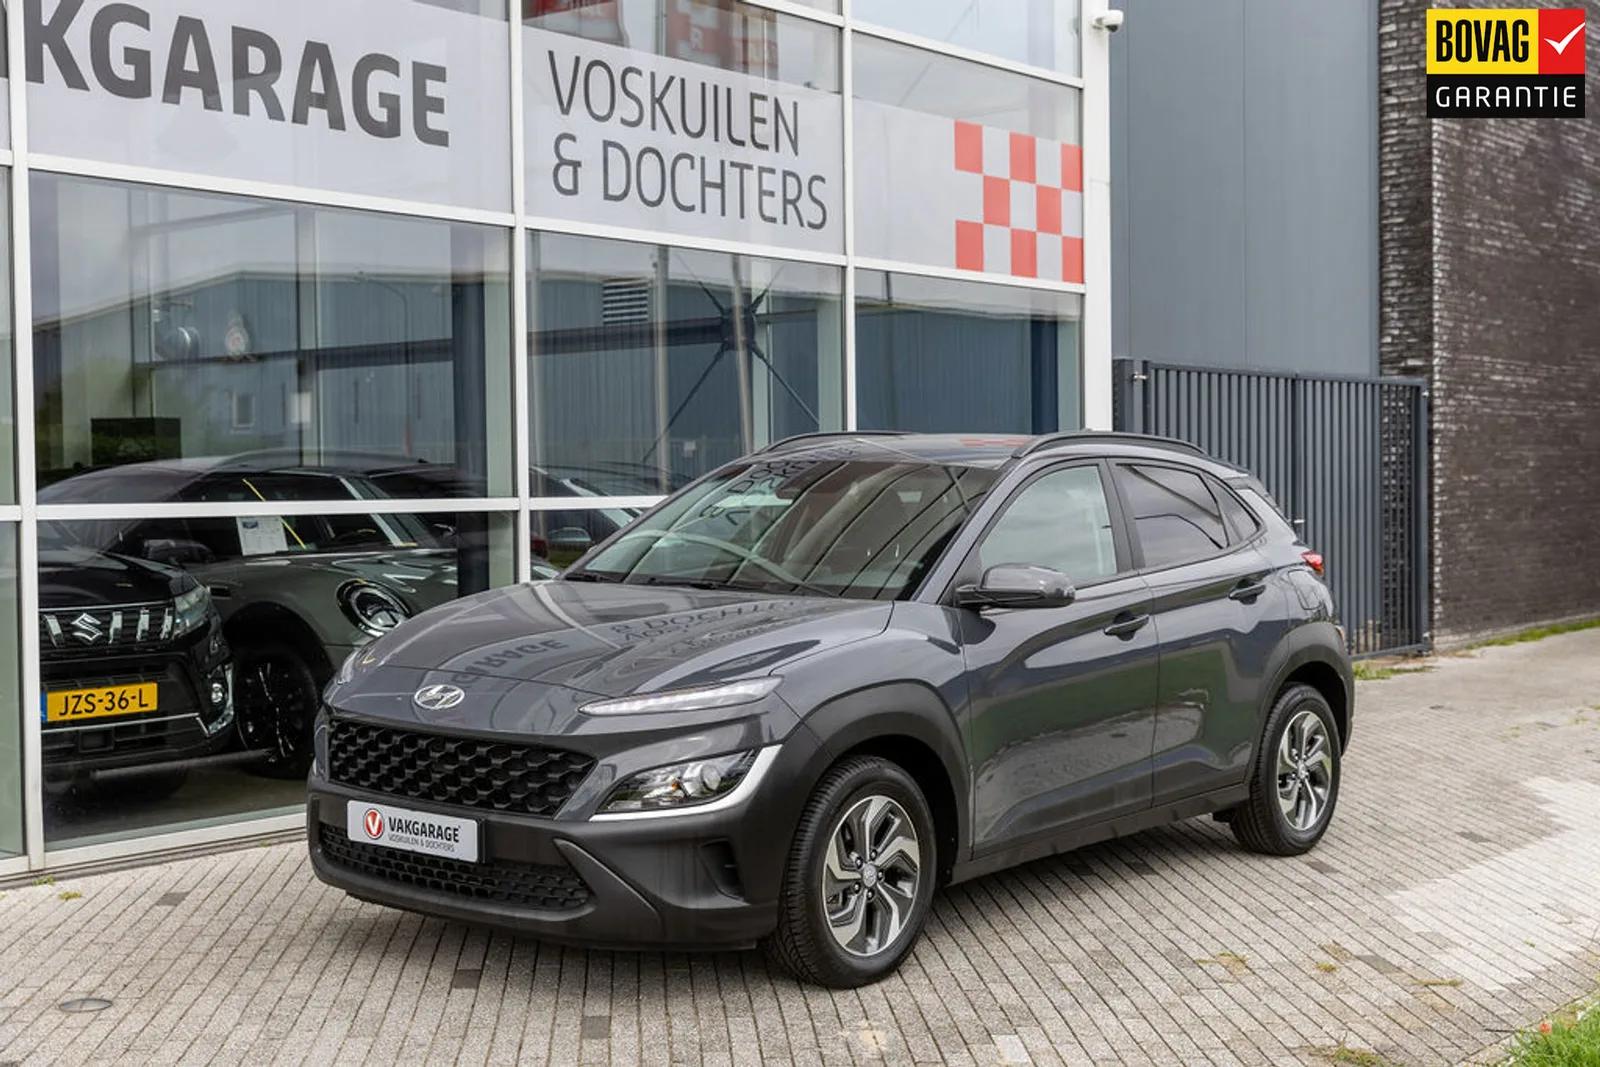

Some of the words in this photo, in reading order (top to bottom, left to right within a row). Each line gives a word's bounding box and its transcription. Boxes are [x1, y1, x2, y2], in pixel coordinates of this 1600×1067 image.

[0, 0, 449, 148] KGARAGE
[548, 50, 799, 156] VOSKUILEN
[552, 132, 583, 196] &
[602, 139, 828, 230] DOCHTERS
[58, 687, 149, 716] JZS-36-L
[388, 816, 460, 844] VAKGARAGE
